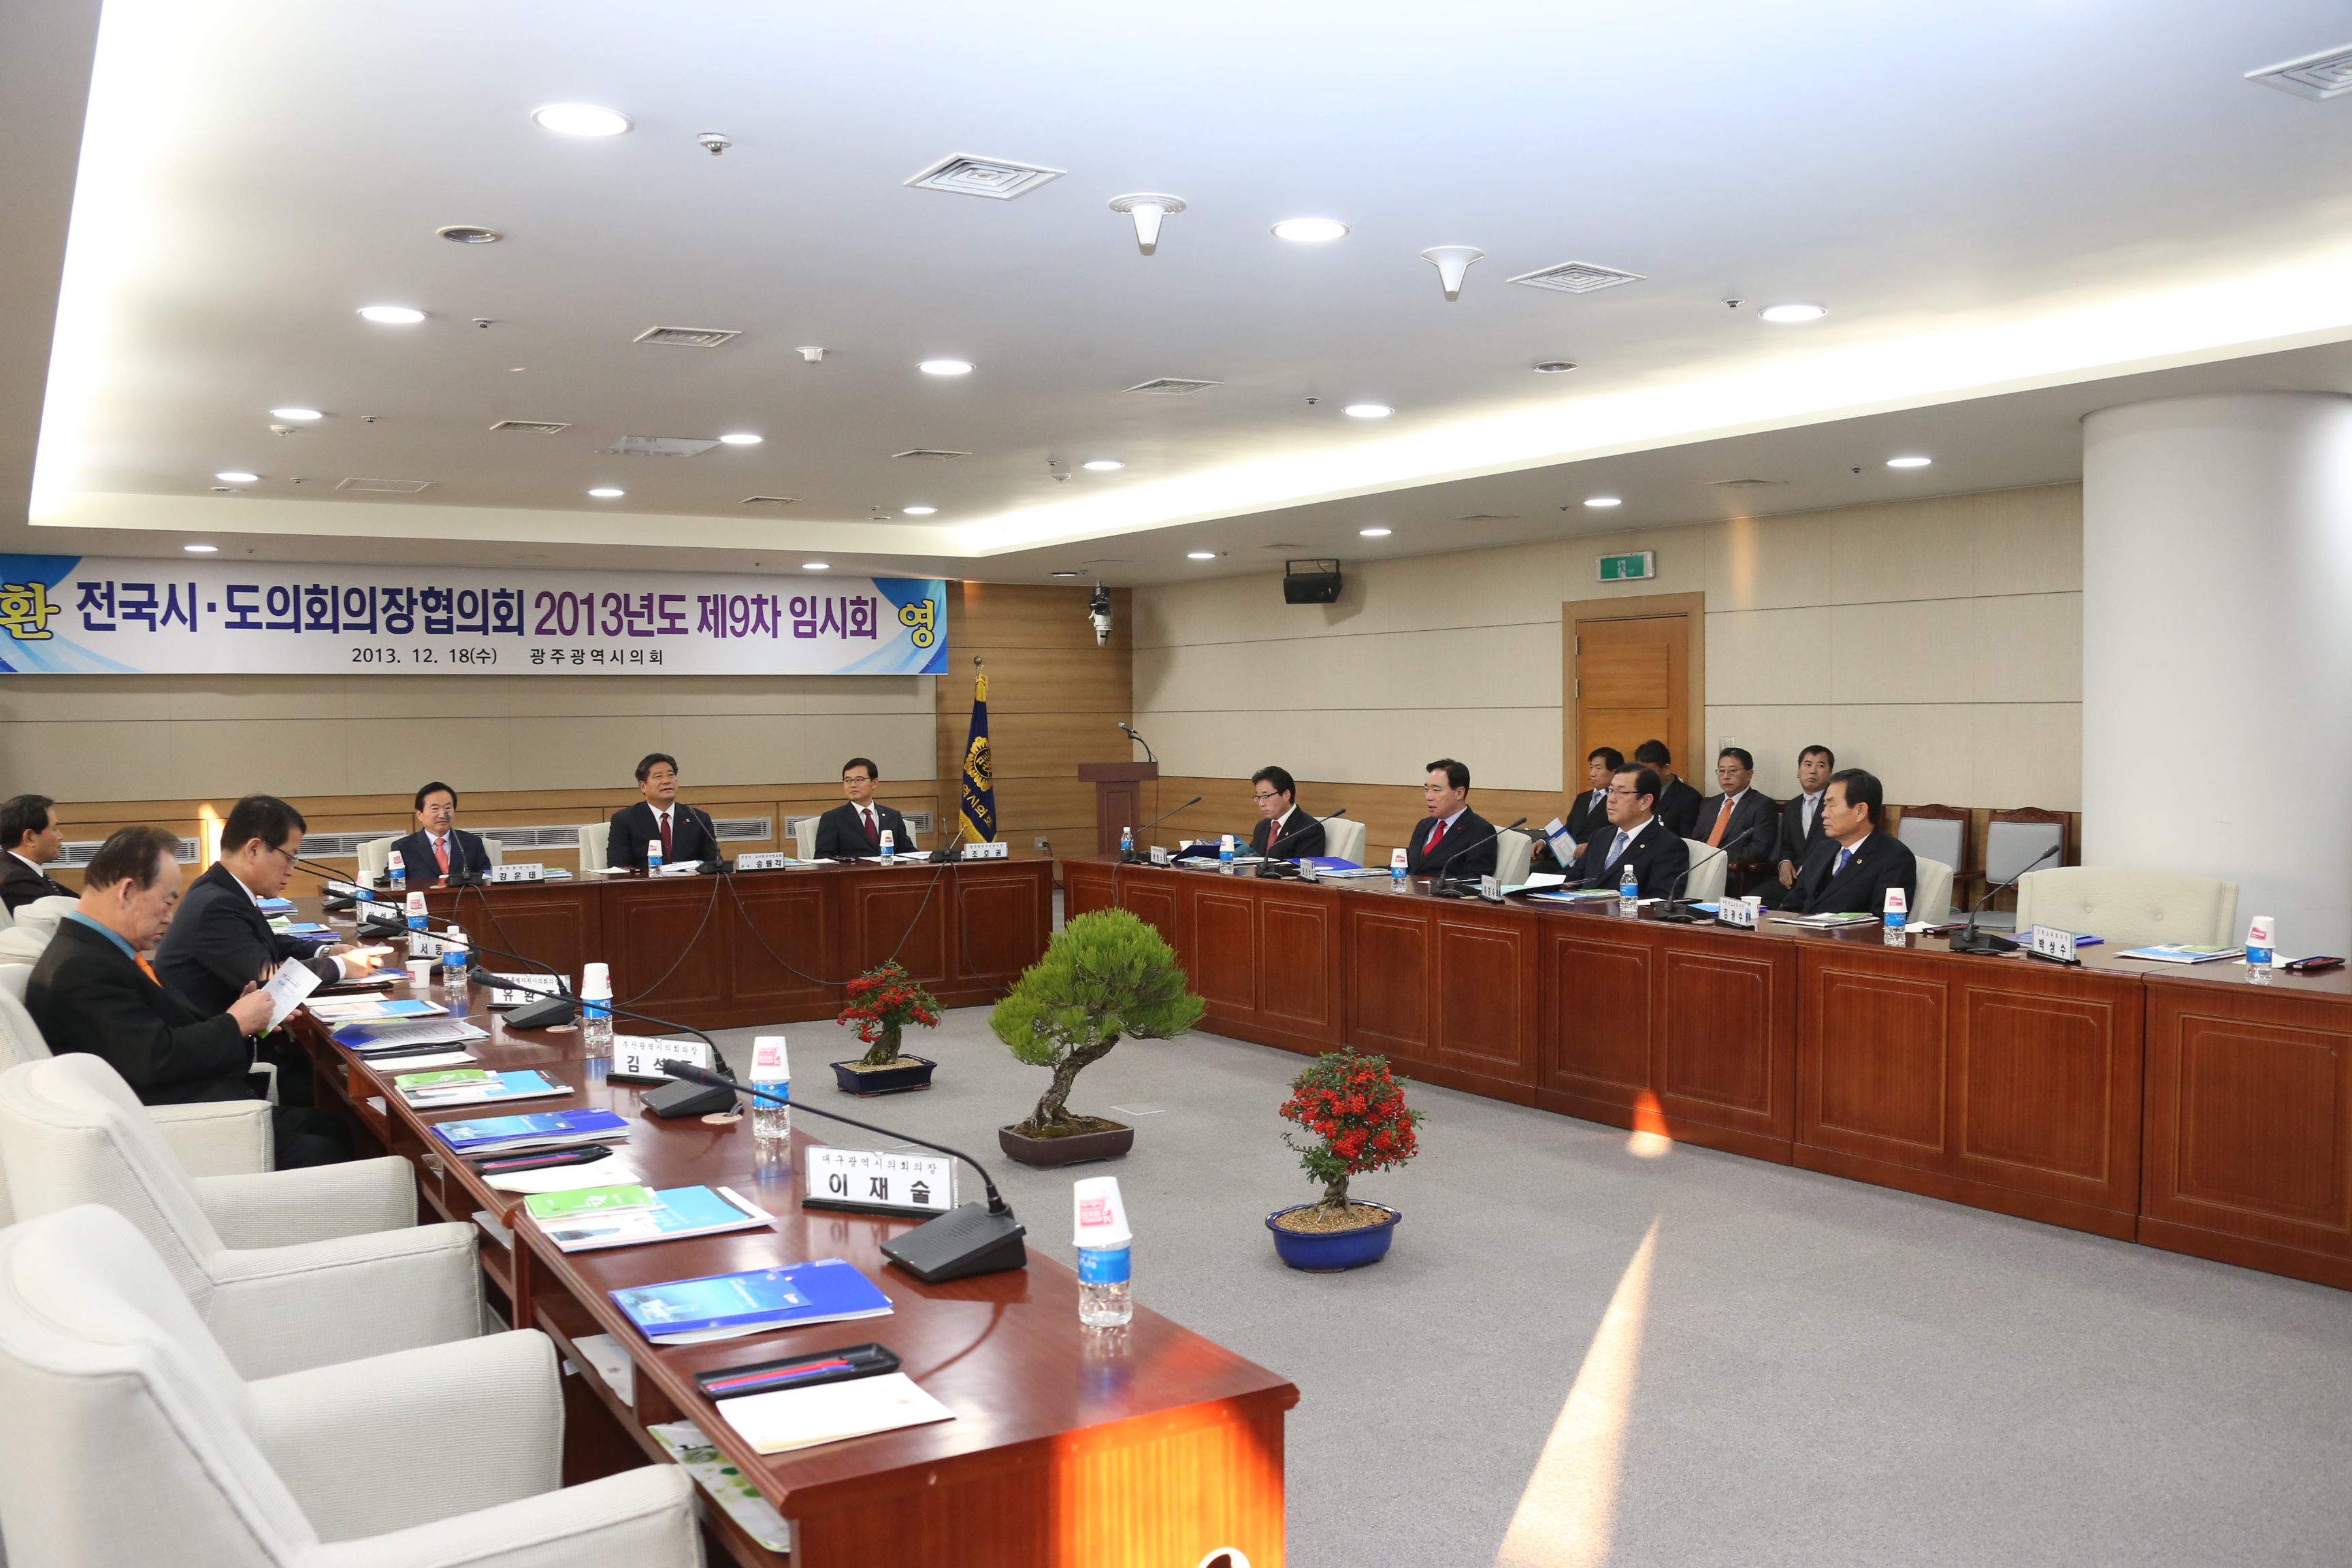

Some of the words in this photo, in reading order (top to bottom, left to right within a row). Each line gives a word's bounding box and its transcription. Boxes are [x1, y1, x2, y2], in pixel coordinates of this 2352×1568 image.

[0, 581, 61, 640] 환
[76, 581, 524, 636] 전국시·도의회의장협의회
[534, 590, 689, 638] 2013년도
[697, 593, 781, 640] 제9차
[789, 595, 877, 640] 임시회
[897, 598, 935, 649] 영
[352, 647, 401, 664] 2013.
[412, 648, 438, 664] 12.
[449, 647, 497, 665] 18(수)
[529, 648, 664, 666] 광주광역시의회
[499, 871, 536, 881] 강운태
[2038, 938, 2066, 957] 박상수
[622, 1041, 698, 1056] 부산광역시의회의장
[627, 1056, 692, 1075] 김석
[821, 1154, 937, 1175] 대구광역시의회의장
[828, 1173, 931, 1205] 이재술
